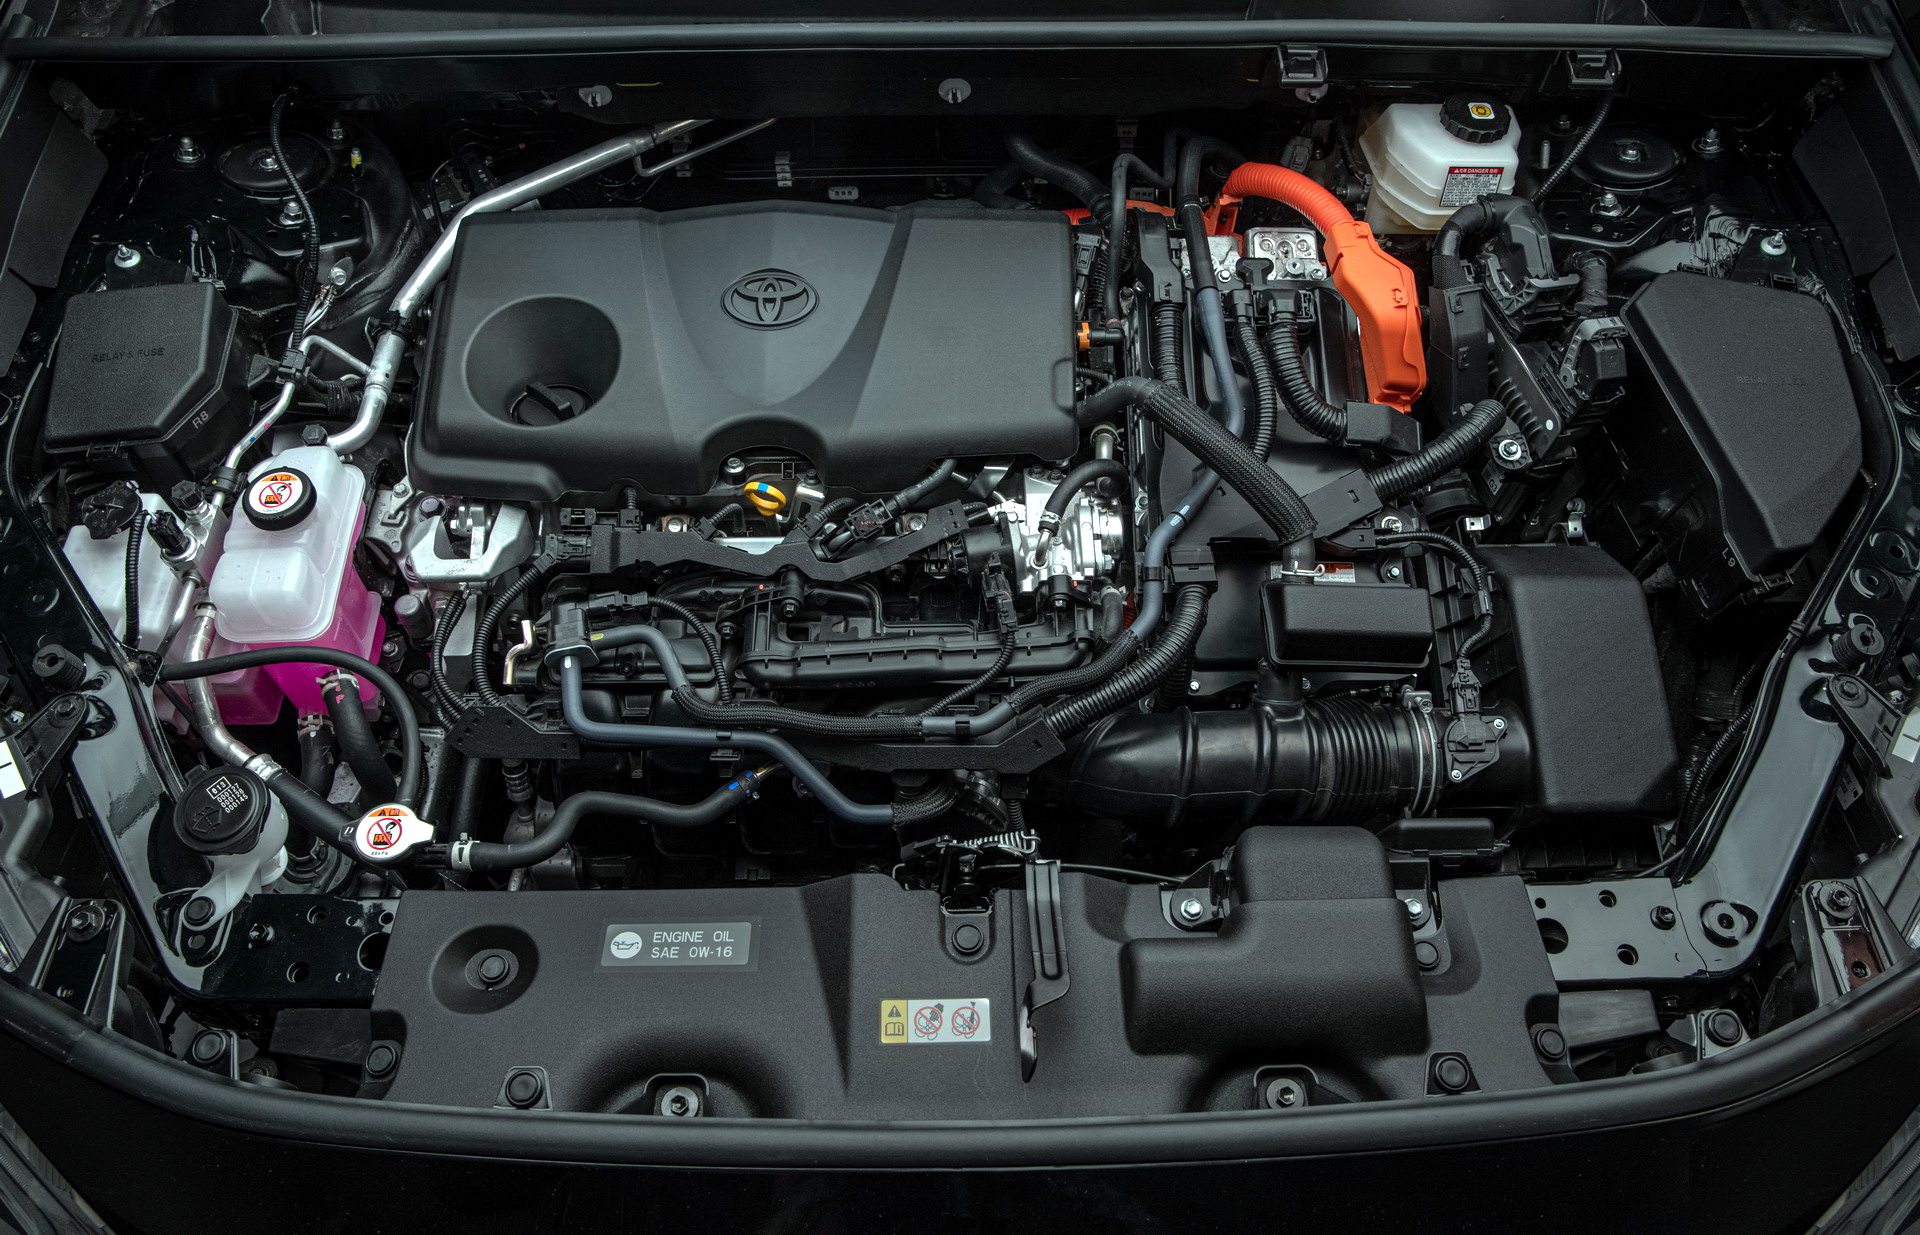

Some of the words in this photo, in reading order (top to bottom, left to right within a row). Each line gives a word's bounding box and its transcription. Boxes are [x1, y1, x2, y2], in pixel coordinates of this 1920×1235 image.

[92, 351, 125, 363] RELAY
[138, 347, 165, 358] FUSE
[192, 410, 209, 429] R8
[216, 782, 240, 803] 000127
[224, 794, 249, 814] 000145
[652, 931, 704, 943] ENGINE
[713, 930, 735, 942] OIL
[650, 946, 680, 959] SAE
[689, 946, 733, 958] 0W-16
